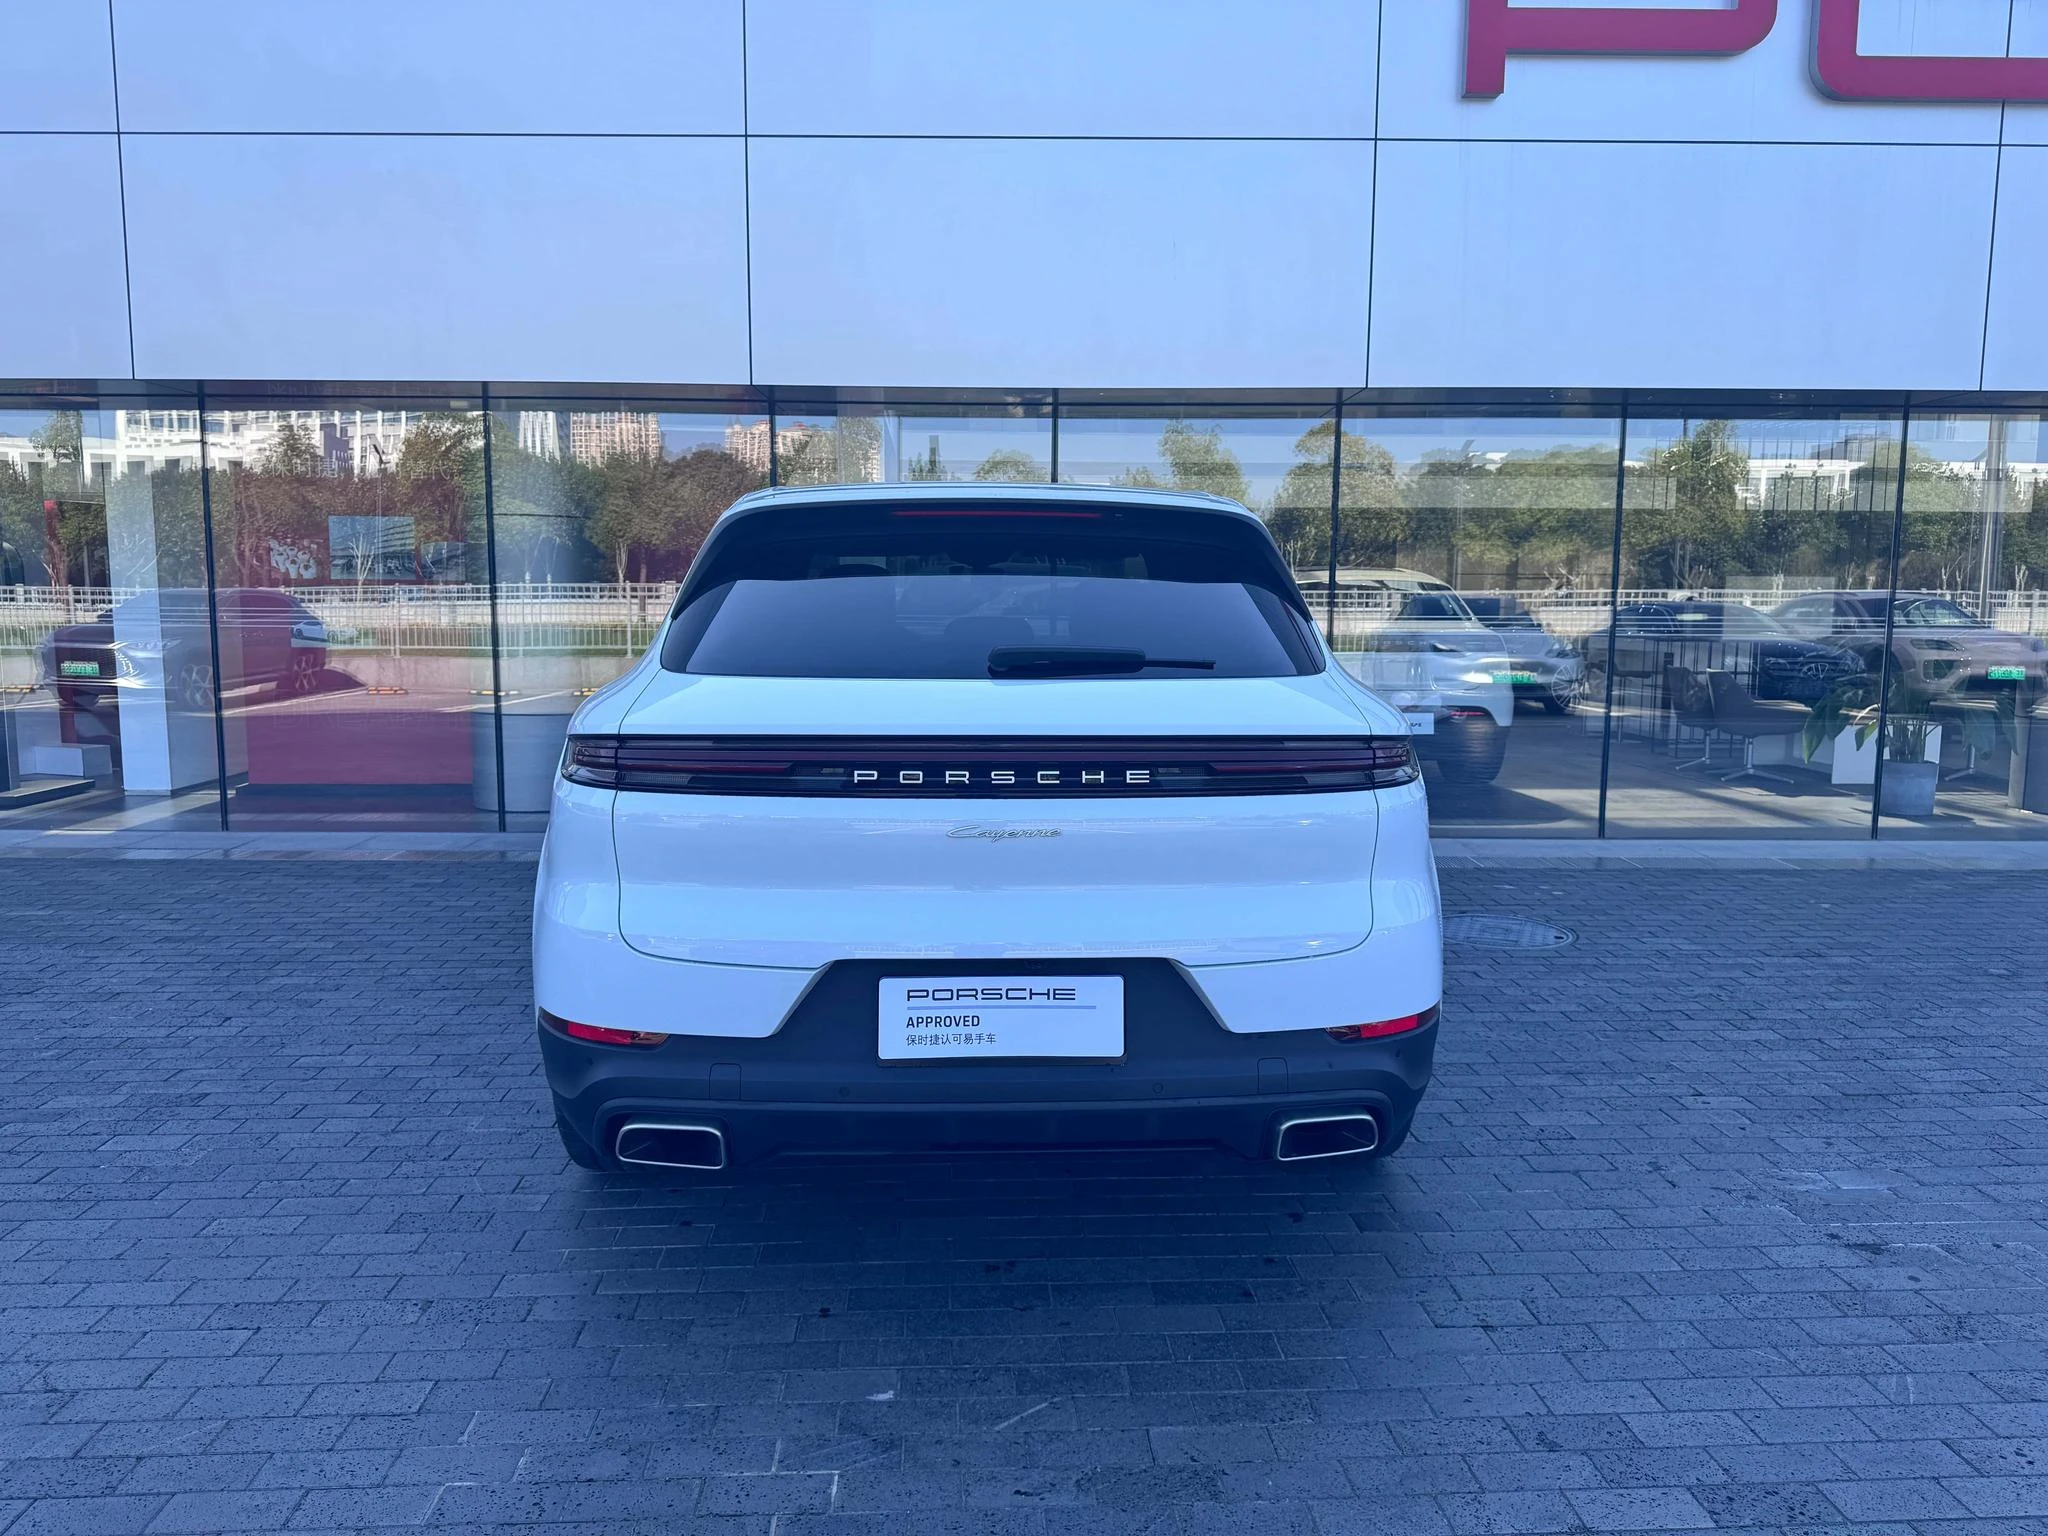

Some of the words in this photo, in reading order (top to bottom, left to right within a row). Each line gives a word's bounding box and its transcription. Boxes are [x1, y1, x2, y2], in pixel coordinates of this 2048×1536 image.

[854, 770, 1150, 784] PORSCHE
[946, 825, 1062, 843] Cayenne
[907, 988, 1076, 1002] PORSCHE
[906, 1015, 980, 1029] APPROVED
[906, 1033, 997, 1046] 保时捷认可易手车
